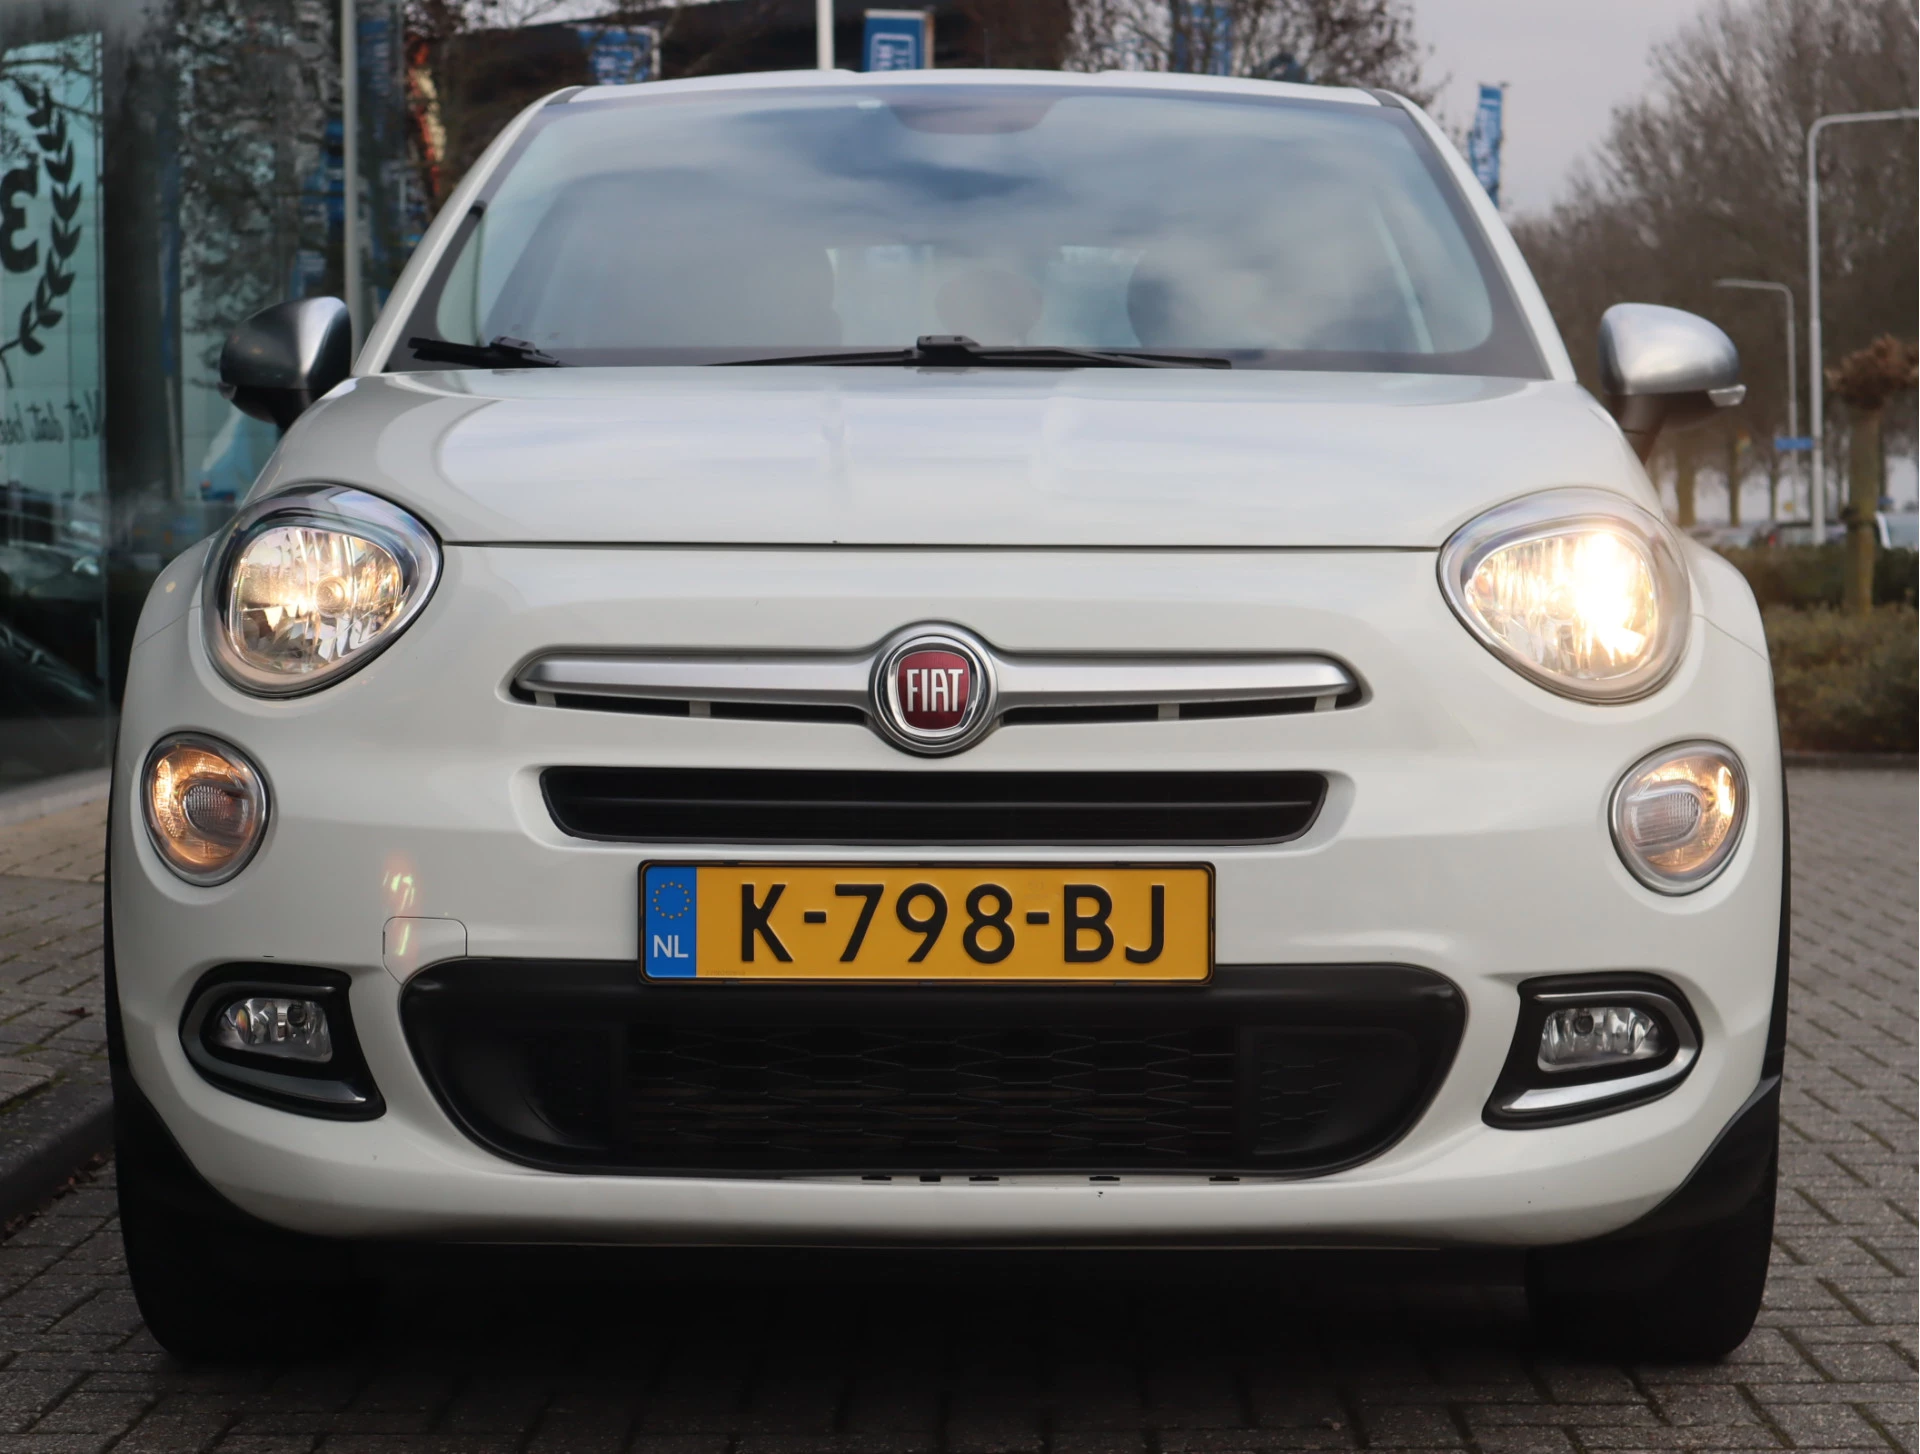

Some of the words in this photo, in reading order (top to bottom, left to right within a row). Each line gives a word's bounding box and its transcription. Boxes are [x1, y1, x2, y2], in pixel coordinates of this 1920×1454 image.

[906, 668, 964, 712] FIAT
[740, 882, 1165, 964] K-798-BJ
[653, 934, 689, 958] NL
